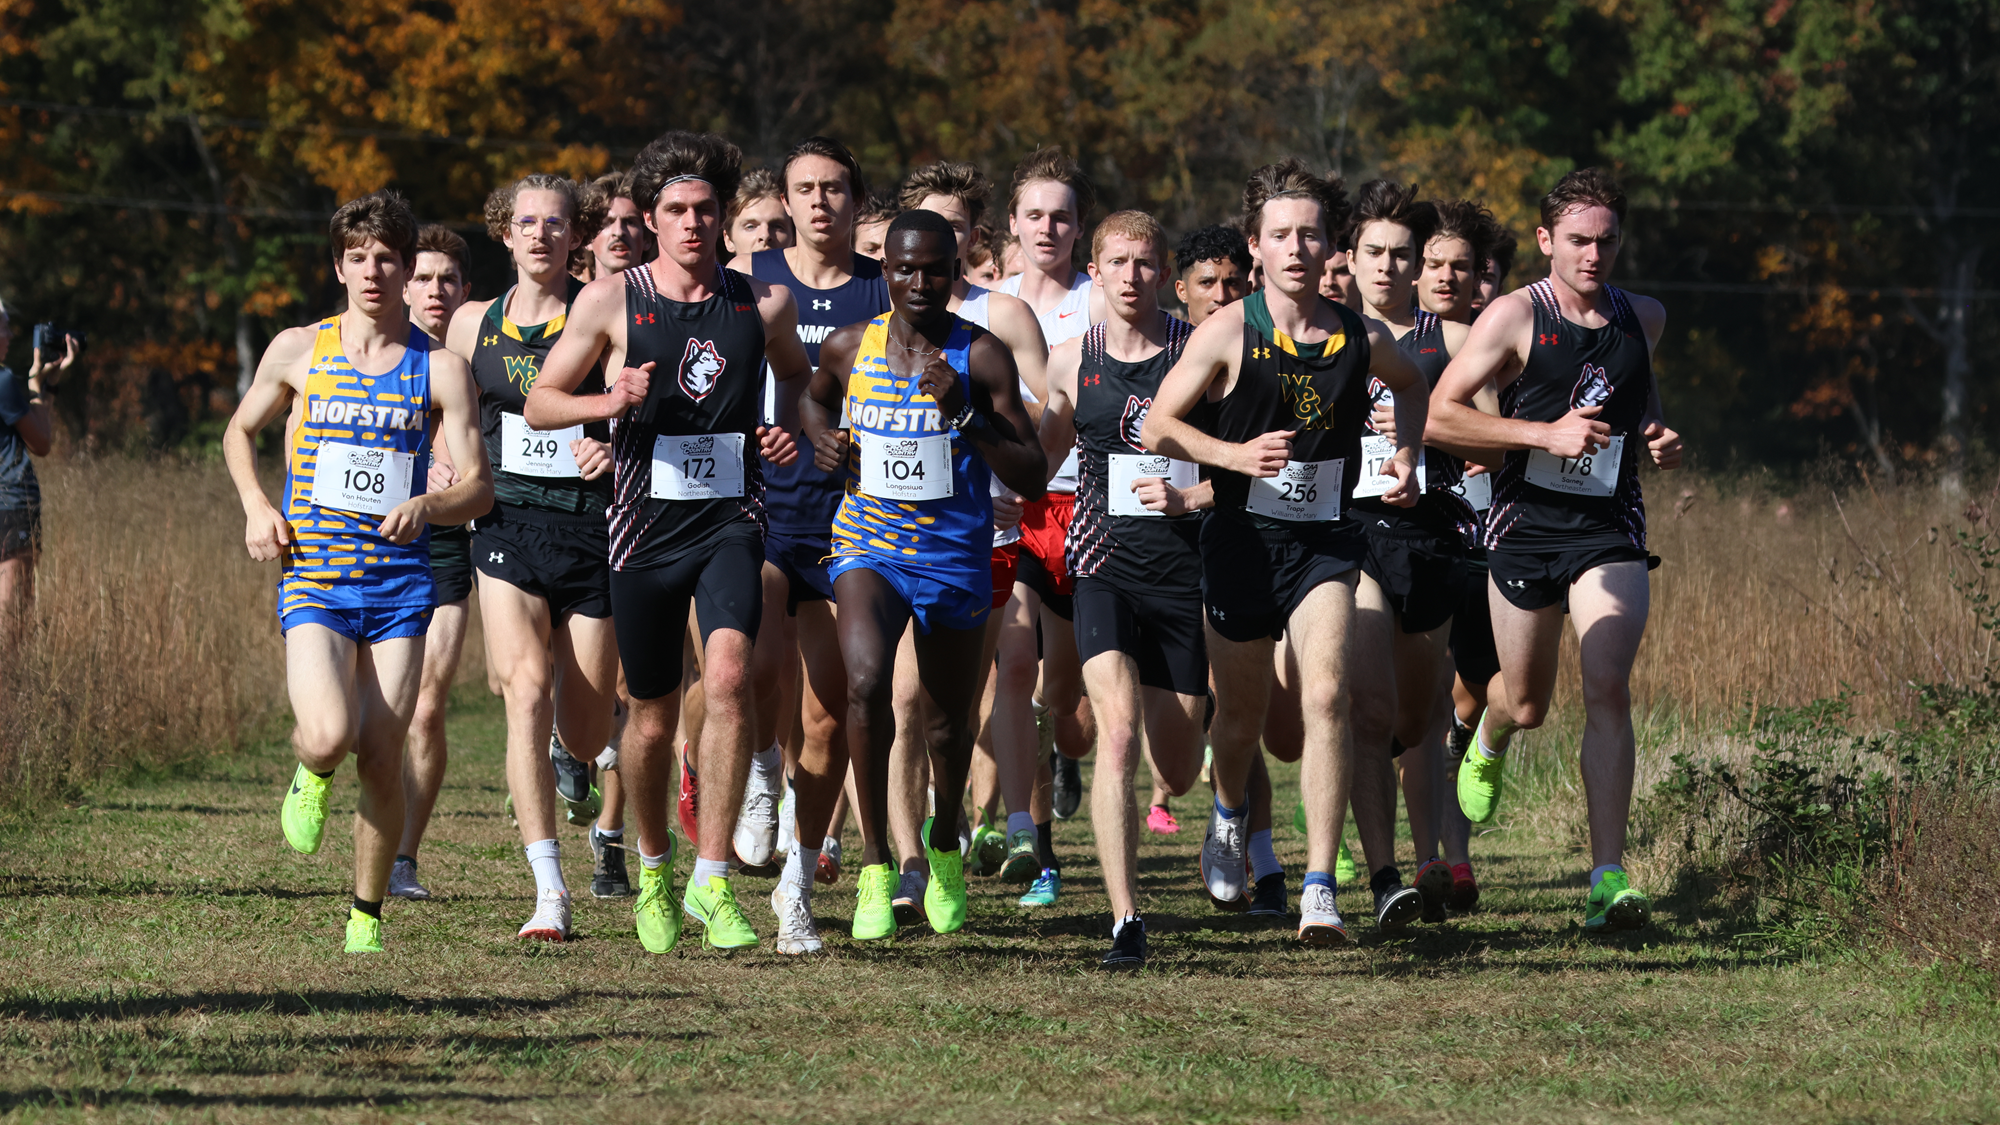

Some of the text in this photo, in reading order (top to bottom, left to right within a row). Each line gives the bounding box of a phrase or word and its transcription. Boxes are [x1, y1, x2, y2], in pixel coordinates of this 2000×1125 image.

[315, 364, 337, 372] CAA
[855, 363, 876, 373] CAA
[1277, 373, 1334, 430] W&M
[310, 401, 423, 431] HOFSTRA
[522, 438, 558, 458] 249
[526, 460, 553, 468] Jennings
[683, 457, 715, 479] 172
[883, 459, 925, 480] 104
[1367, 456, 1392, 477] 17
[1560, 456, 1592, 476] 178
[344, 469, 385, 494] 108
[1550, 481, 1592, 493] Northeastern
[356, 495, 381, 504] Houten
[678, 489, 719, 497] Northeastern
[892, 490, 916, 498] Hofstra
[1278, 481, 1317, 503] 256
[347, 501, 372, 510] Hofstra
[1271, 509, 1294, 518] William
